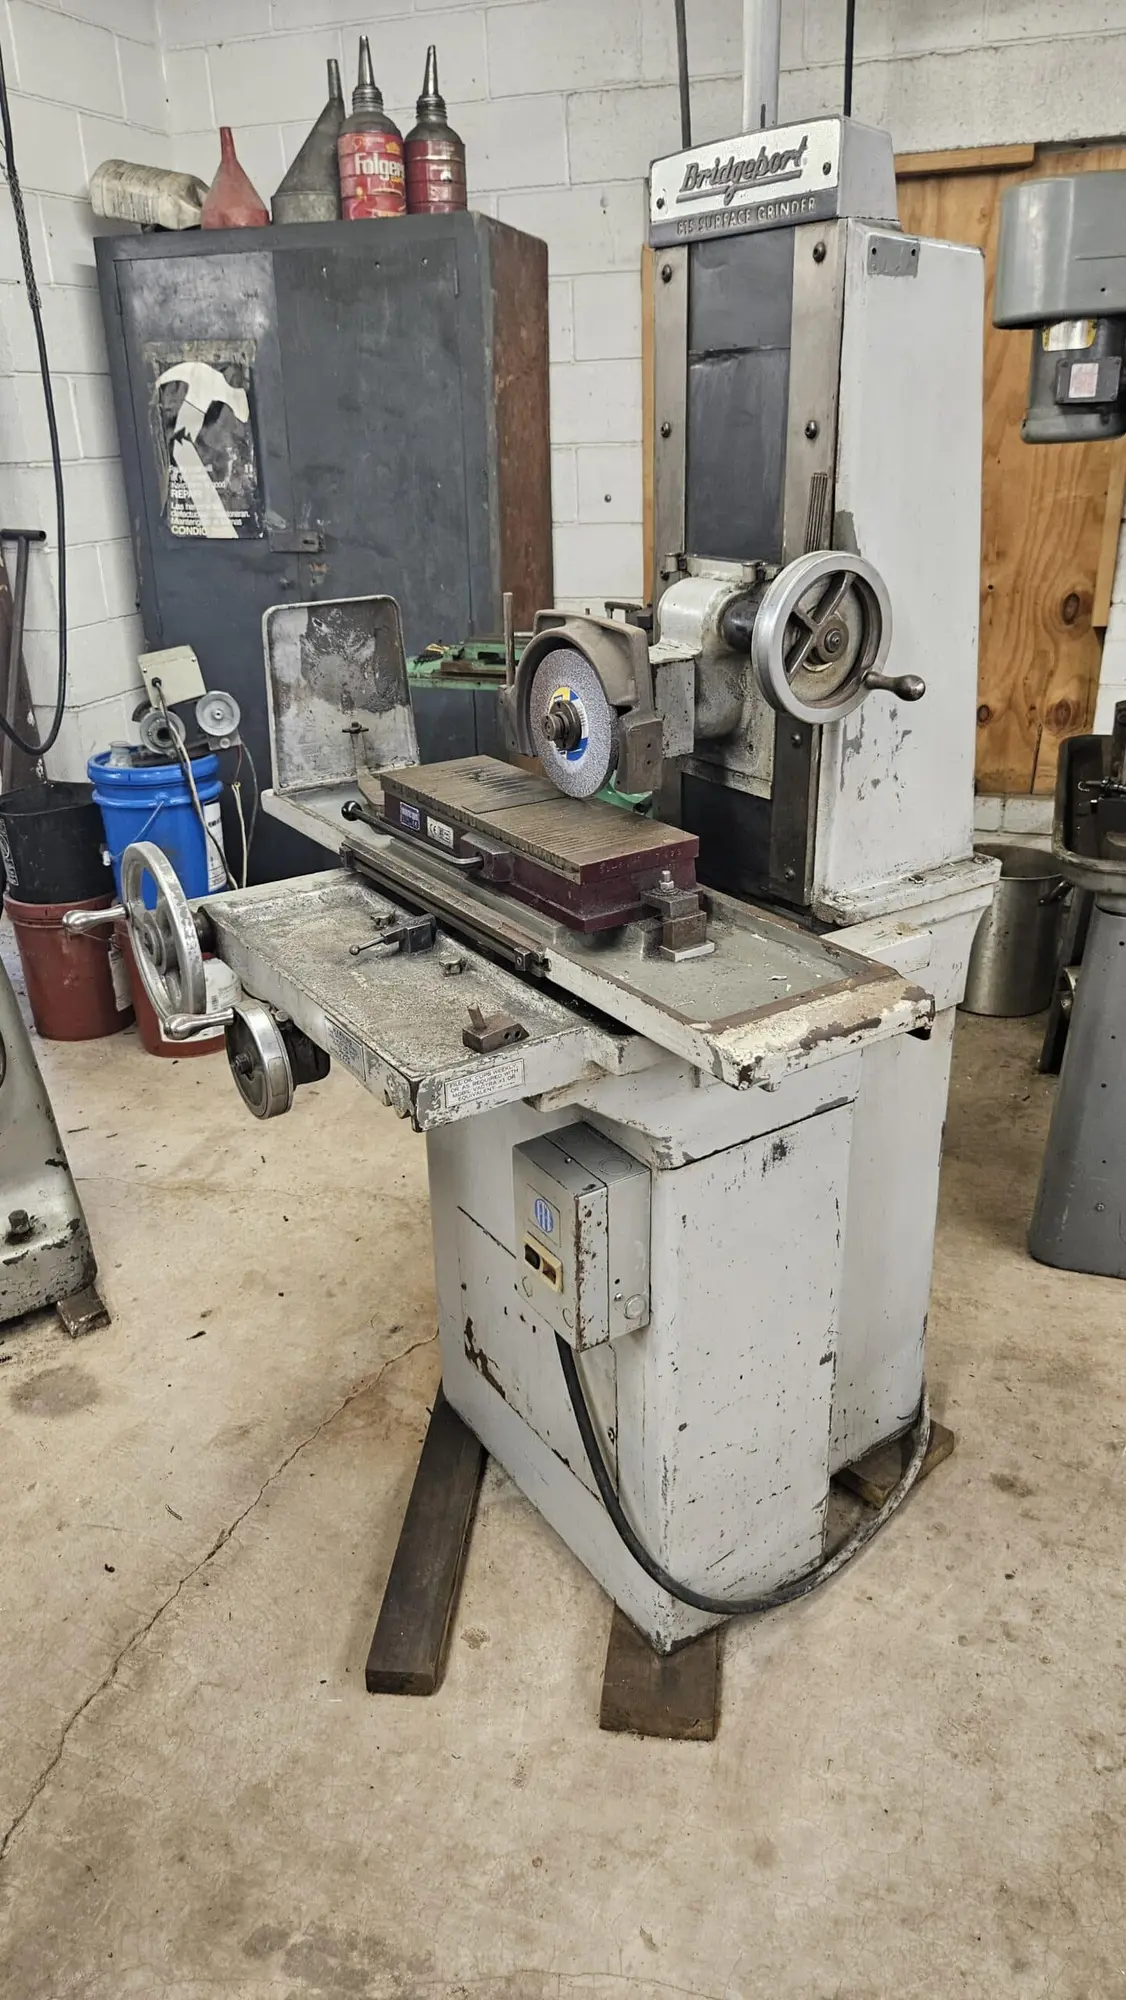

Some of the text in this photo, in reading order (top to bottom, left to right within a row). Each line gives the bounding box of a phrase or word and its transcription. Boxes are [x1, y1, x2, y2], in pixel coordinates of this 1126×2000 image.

[679, 135, 808, 206] Bridgeport
[698, 210, 751, 233] SURFACE
[757, 197, 815, 221] GRINDER
[472, 1074, 502, 1087] REQUIRED
[504, 1068, 519, 1076] WITH
[452, 1089, 471, 1098] MOBIL
[458, 1086, 496, 1102] EQUIVALENT
